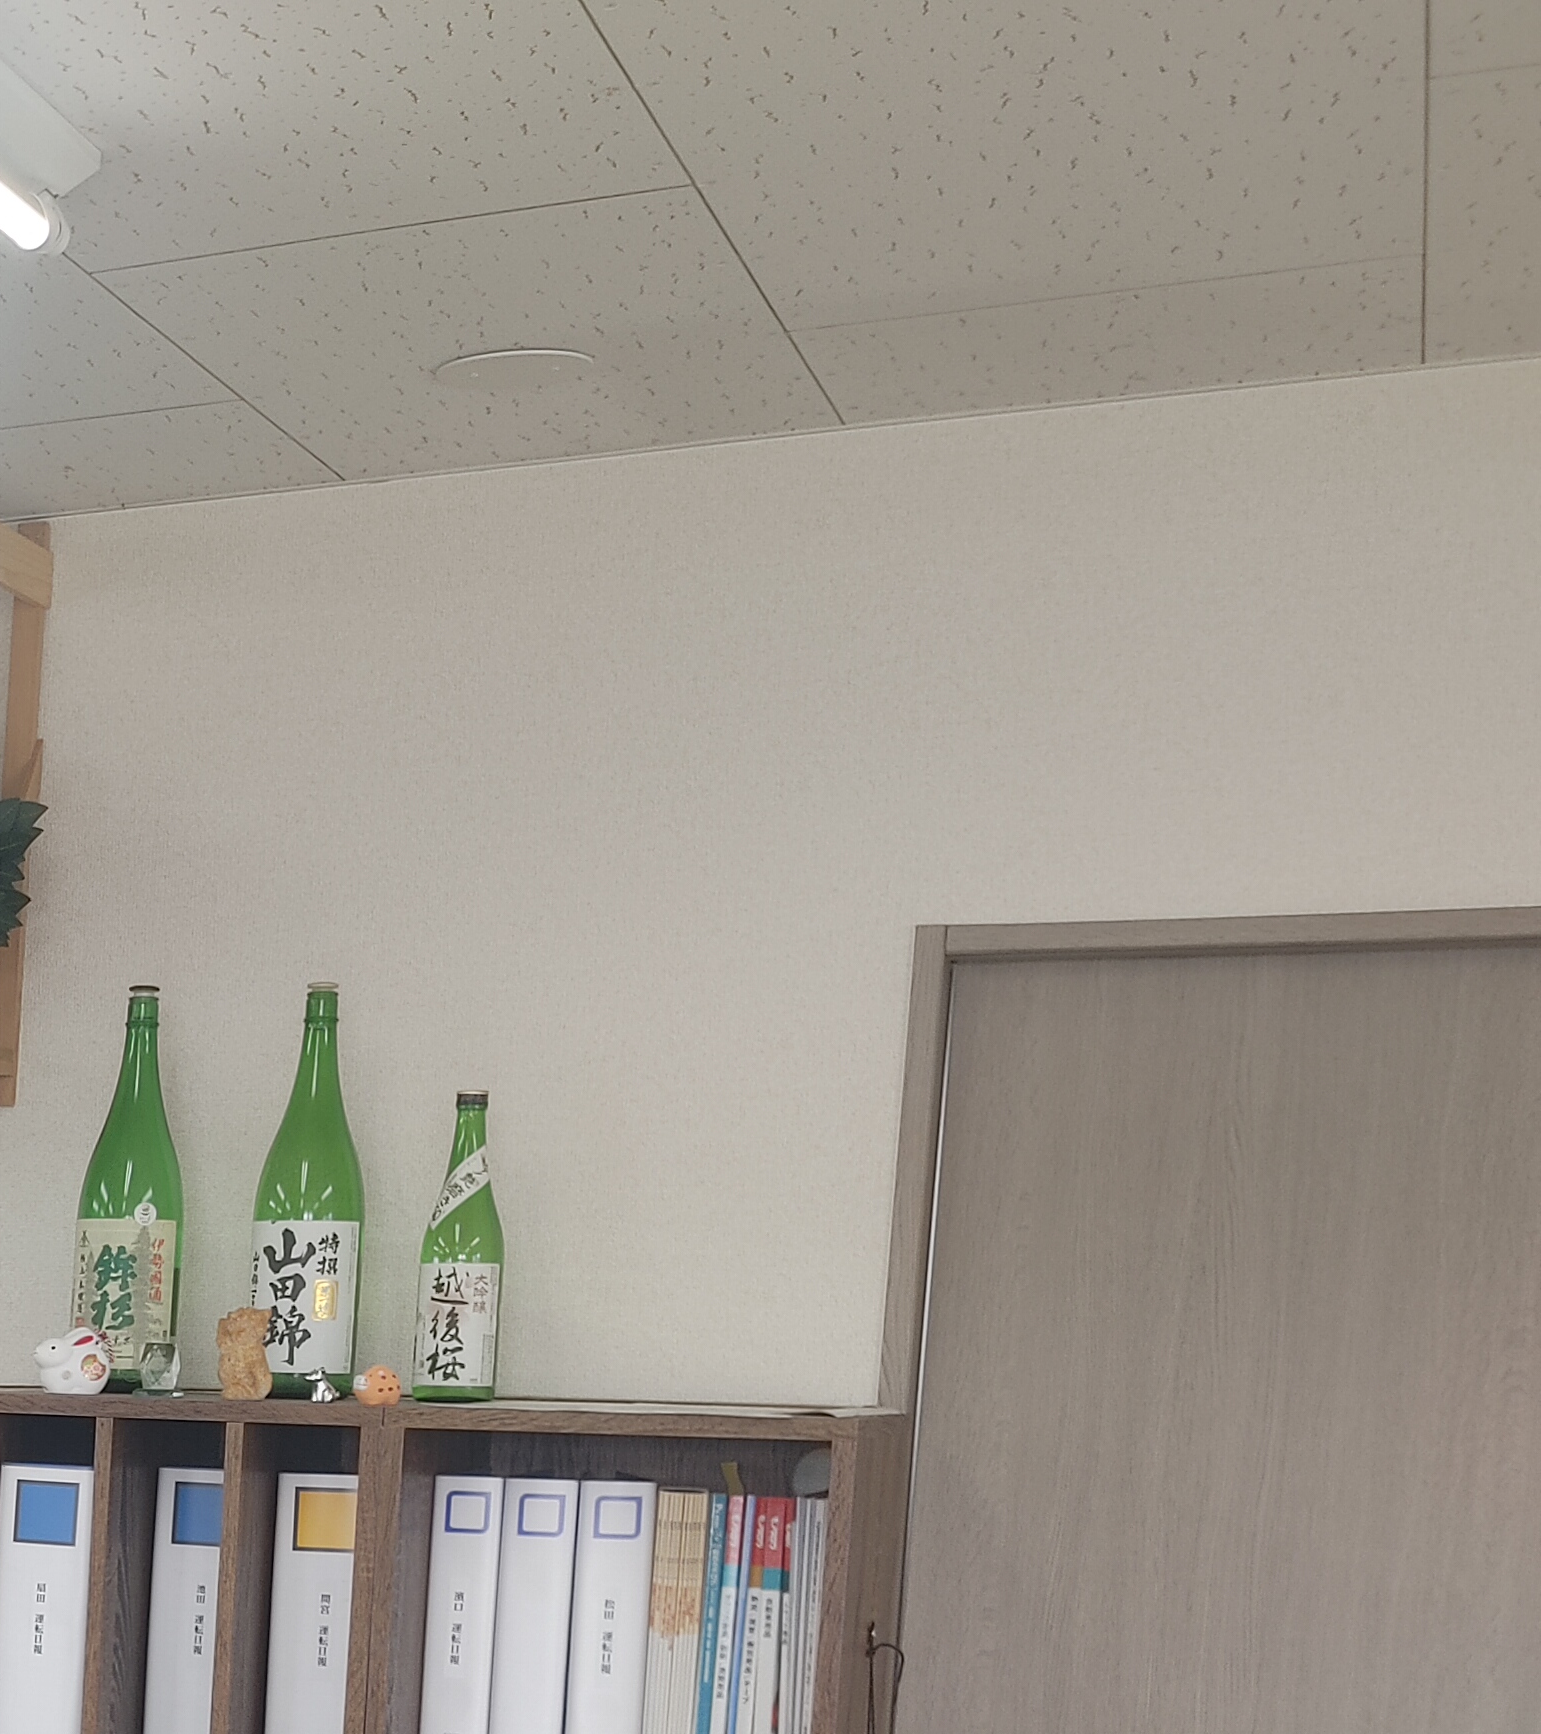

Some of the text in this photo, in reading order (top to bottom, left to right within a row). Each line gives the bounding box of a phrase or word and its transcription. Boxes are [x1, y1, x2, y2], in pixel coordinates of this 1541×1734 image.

[263, 1227, 317, 1367] 山田錦
[425, 1266, 470, 1382] 越後桜
[33, 1613, 45, 1655] 運転日報
[193, 1614, 205, 1656] 運転日報
[317, 1625, 329, 1667] 運転日報
[449, 1623, 463, 1666] 運転日報
[600, 1631, 614, 1675] 運転日報
